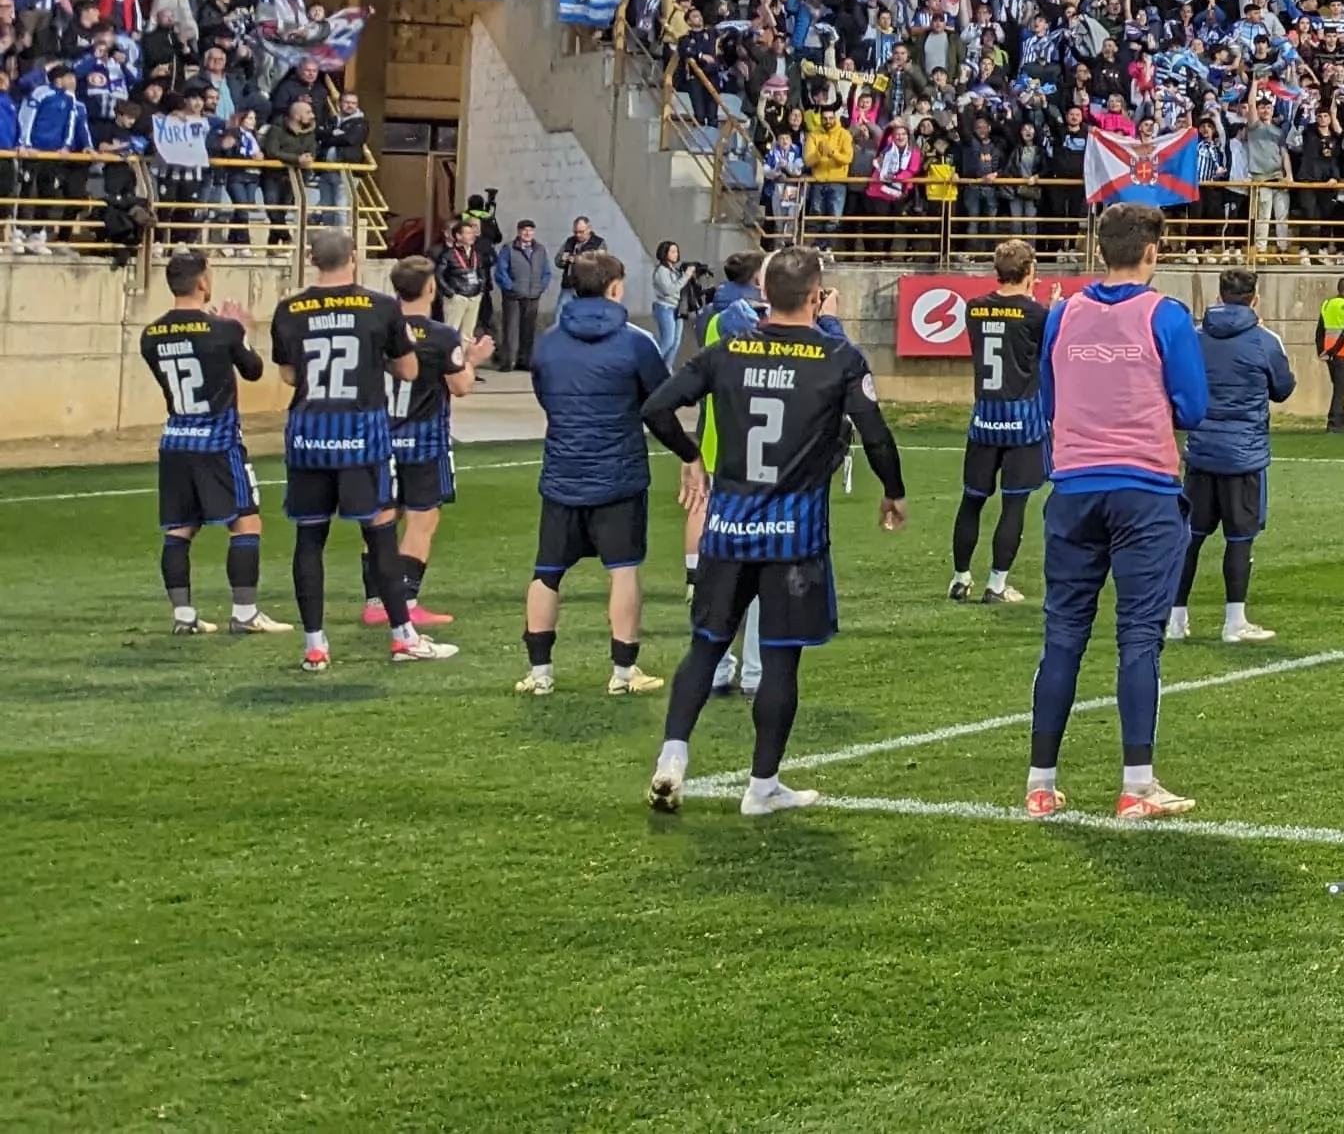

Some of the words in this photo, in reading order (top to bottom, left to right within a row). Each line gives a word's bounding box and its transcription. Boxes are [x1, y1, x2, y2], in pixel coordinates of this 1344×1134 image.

[289, 299, 322, 313] CAJA
[728, 339, 766, 356] CAJA
[303, 335, 360, 401] 22
[983, 337, 1003, 390] 5
[159, 357, 211, 415] 12
[744, 368, 768, 388] ALE
[769, 365, 796, 389] DÍEZ
[304, 438, 366, 450] VALCARCE
[747, 397, 785, 484] 2
[719, 519, 796, 535] VALCARCE
